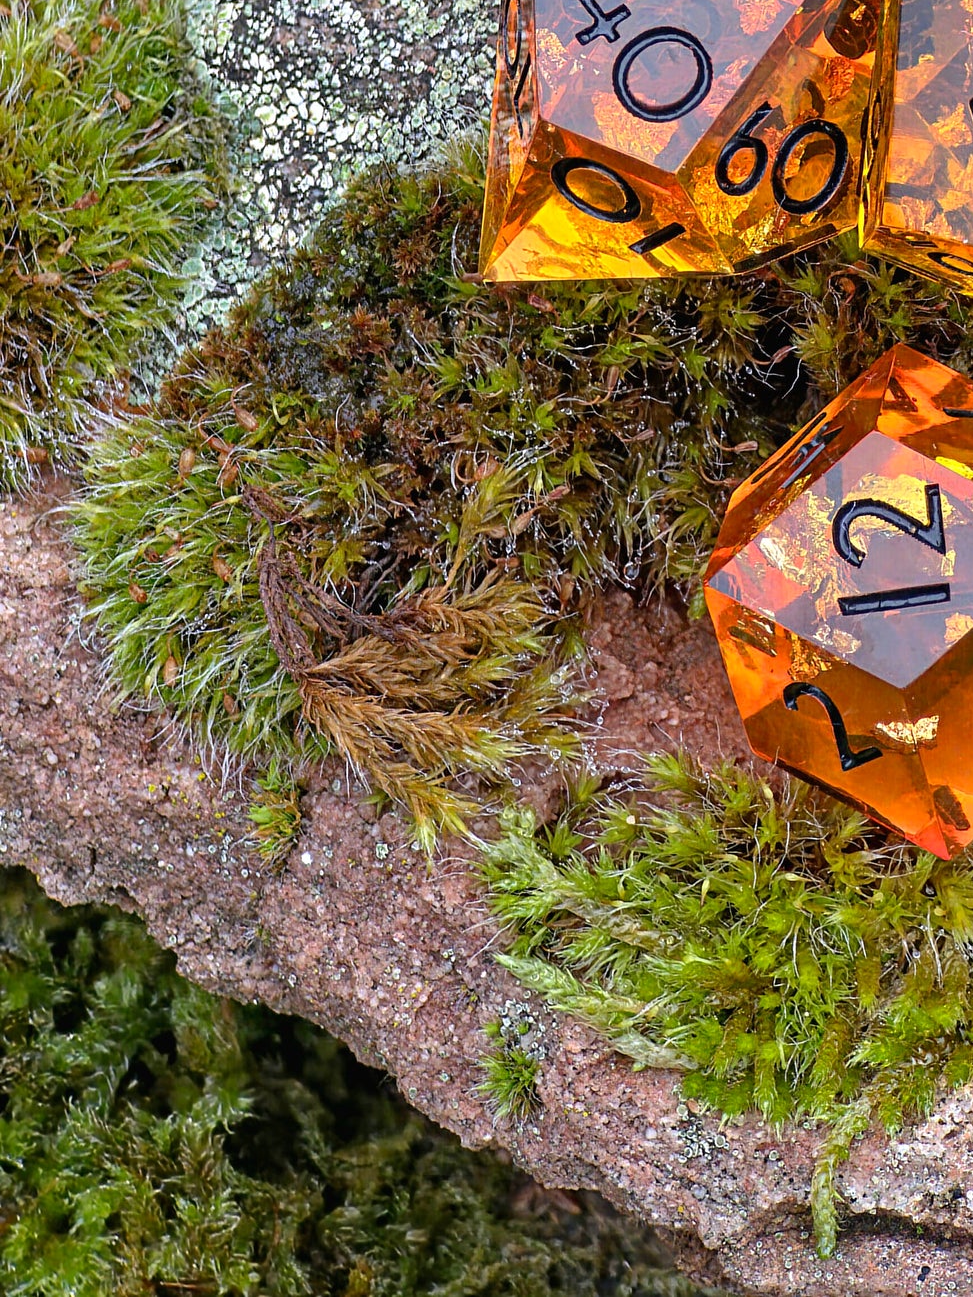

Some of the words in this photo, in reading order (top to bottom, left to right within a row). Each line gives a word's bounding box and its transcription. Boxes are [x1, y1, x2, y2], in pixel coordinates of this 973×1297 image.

[714, 100, 849, 215] 60
[831, 482, 952, 617] 12
[782, 680, 884, 773] 2
